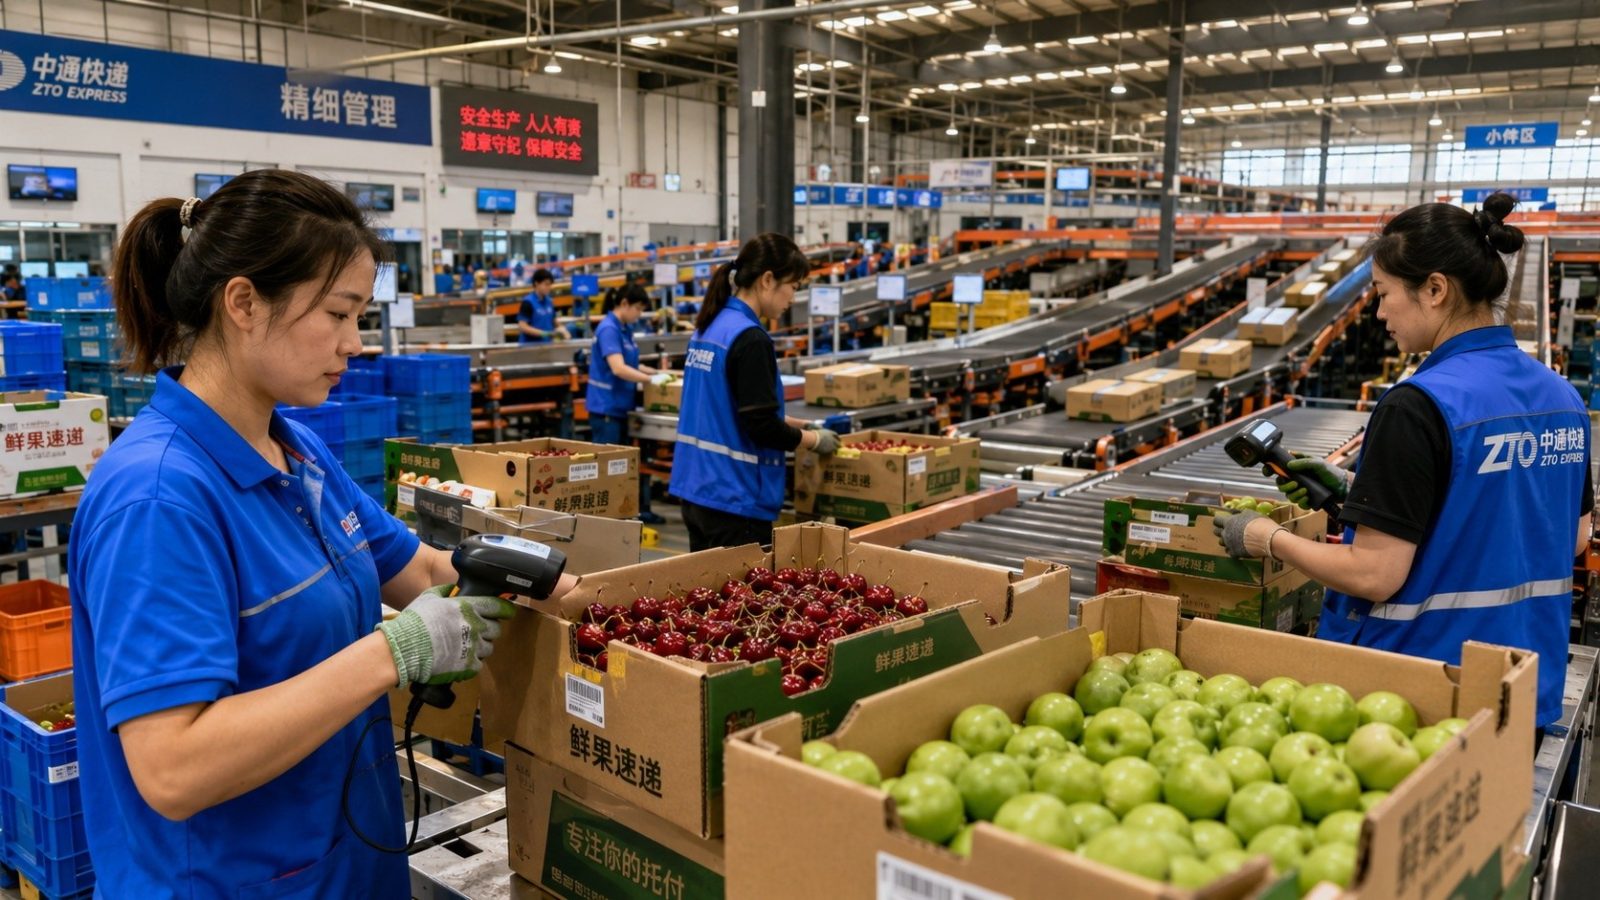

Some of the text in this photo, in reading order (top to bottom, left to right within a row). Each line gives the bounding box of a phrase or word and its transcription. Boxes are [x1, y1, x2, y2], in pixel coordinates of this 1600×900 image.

[32, 52, 129, 88] 中通快递
[32, 82, 127, 103] ZTO EXPRESS
[280, 82, 397, 129] 精细管理
[460, 105, 582, 138] 安全生产 人人有责
[1477, 431, 1538, 475] ZTO
[1540, 427, 1585, 453] 中通快递
[1540, 455, 1558, 466] ZTO
[569, 723, 663, 798] 鲜果速递
[566, 821, 685, 900] 专注你的托付
